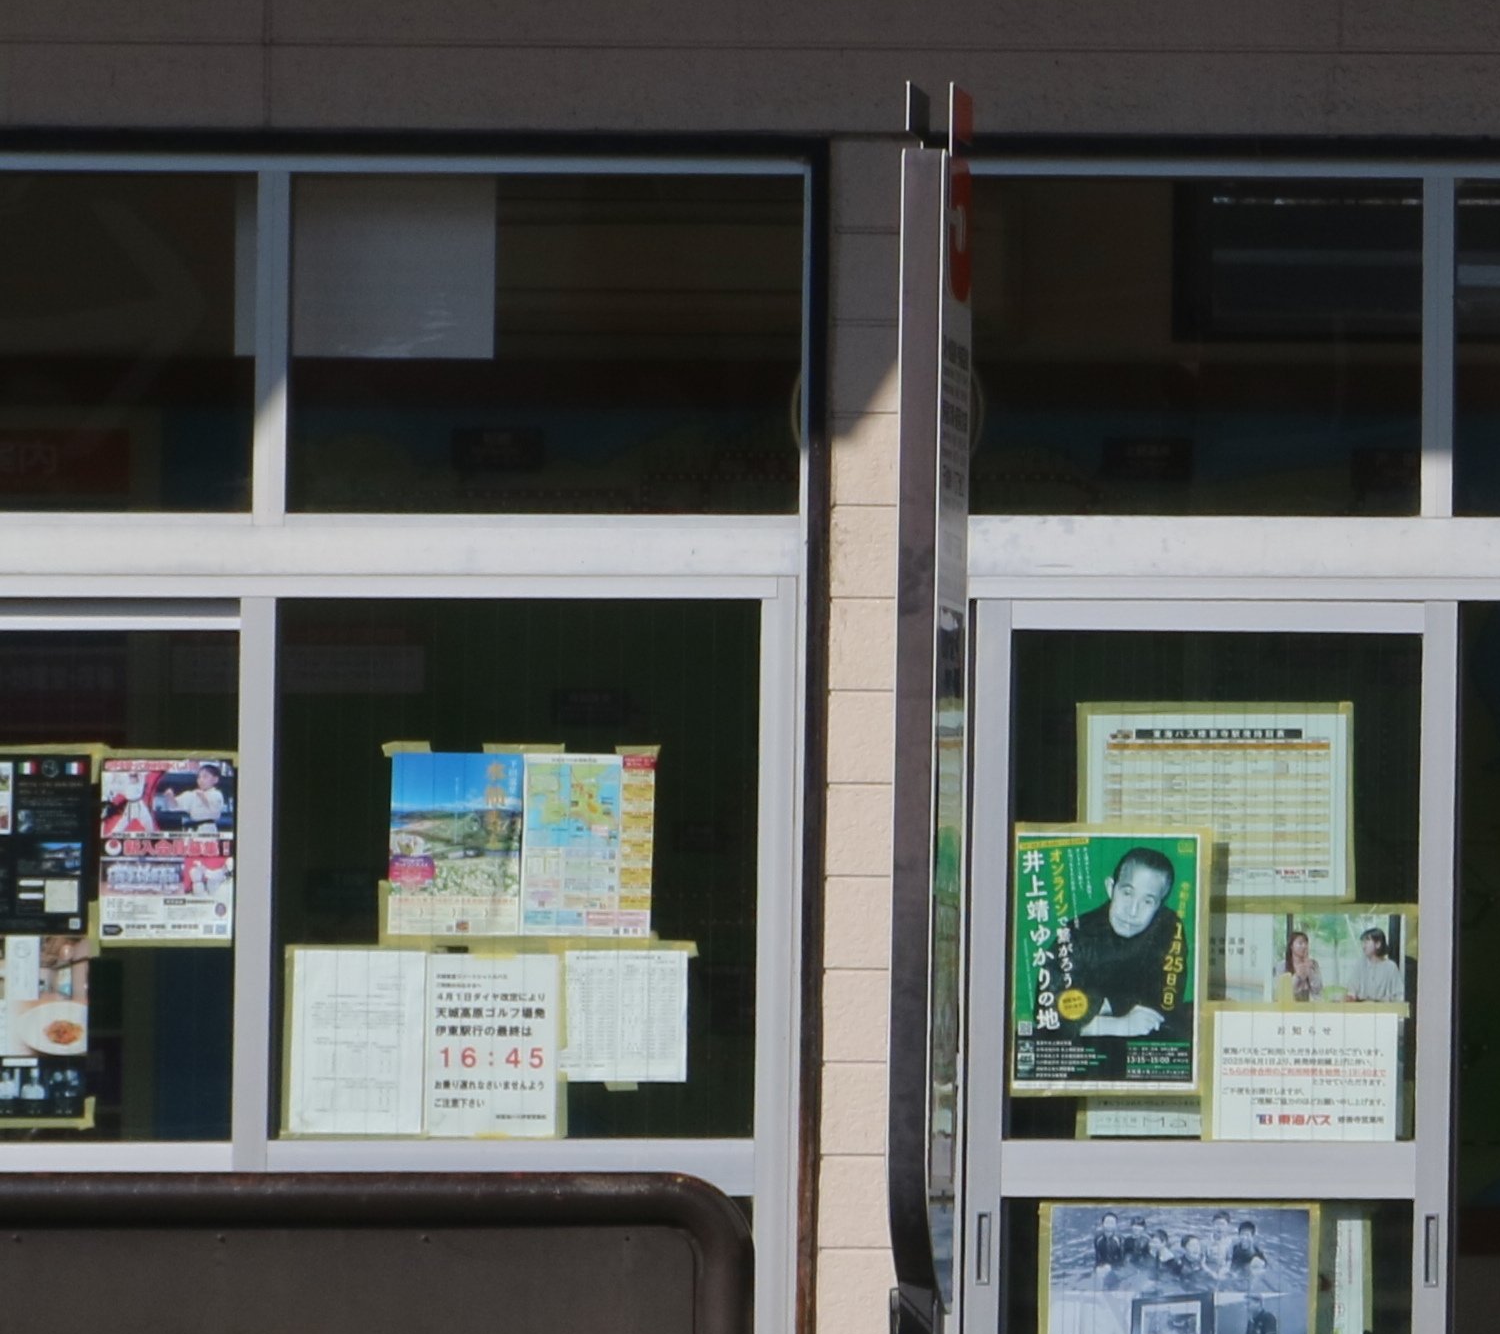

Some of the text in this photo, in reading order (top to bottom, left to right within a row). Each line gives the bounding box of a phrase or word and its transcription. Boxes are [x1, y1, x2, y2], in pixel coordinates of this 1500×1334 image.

[1022, 850, 1061, 1030] 井上靖ゆかりの地
[435, 1007, 546, 1019] 天城高原ゴルフ場発
[435, 1025, 532, 1037] 伊東駅行の最終は
[434, 1098, 486, 1108] ご注意下さい
[1278, 1114, 1332, 1126] 東海バス
